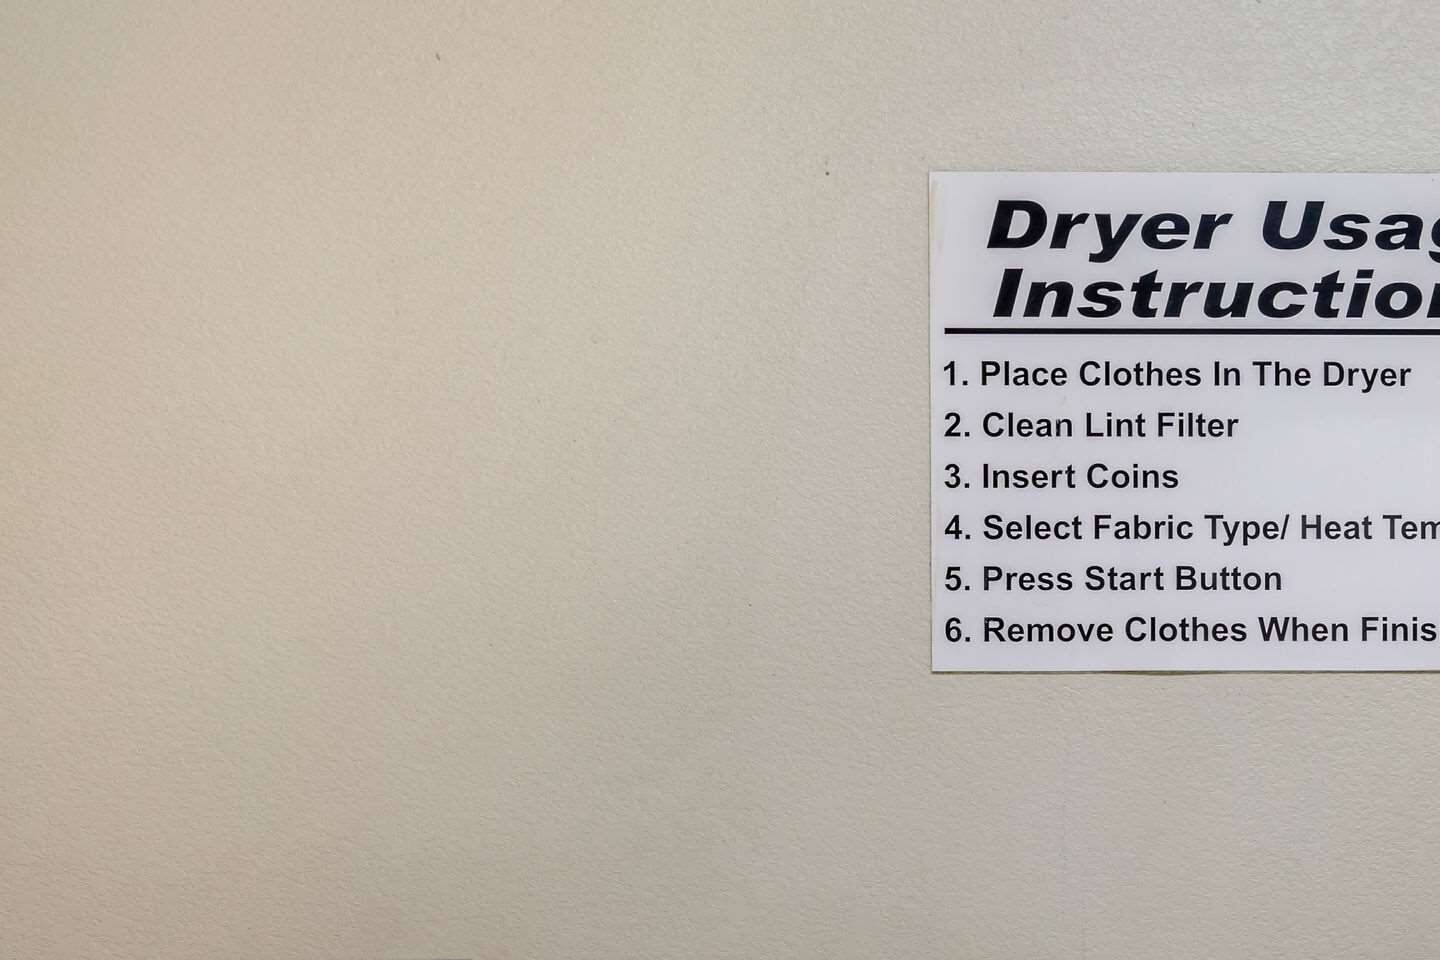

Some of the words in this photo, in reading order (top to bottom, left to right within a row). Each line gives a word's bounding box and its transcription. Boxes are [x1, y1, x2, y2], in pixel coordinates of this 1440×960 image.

[987, 200, 1233, 263] Dryer
[943, 360, 969, 387] 1.
[981, 360, 1068, 387] Place
[1079, 360, 1202, 387] Clothes
[1214, 360, 1241, 387] In
[1252, 360, 1312, 387] The
[1323, 361, 1412, 394] Dryer
[944, 412, 970, 438] 2.
[982, 412, 1073, 438] Clean
[1086, 412, 1146, 438] Lint
[1157, 412, 1239, 438] Filter
[944, 463, 970, 489] 3.
[983, 463, 1076, 489] Insert
[1086, 463, 1179, 489] Coins
[944, 514, 971, 540] 4.
[983, 514, 1083, 540] Select
[1094, 514, 1194, 540] Fabric
[1203, 514, 1290, 547] Type/
[1301, 514, 1373, 540] Heat
[944, 566, 970, 592] 5.
[983, 566, 1073, 592] Press
[1084, 566, 1165, 592] Start
[1175, 566, 1282, 592] Button
[945, 616, 971, 643] 6.
[983, 616, 1114, 643] Remove
[1125, 616, 1247, 643] Clothes
[1257, 616, 1349, 643] When
